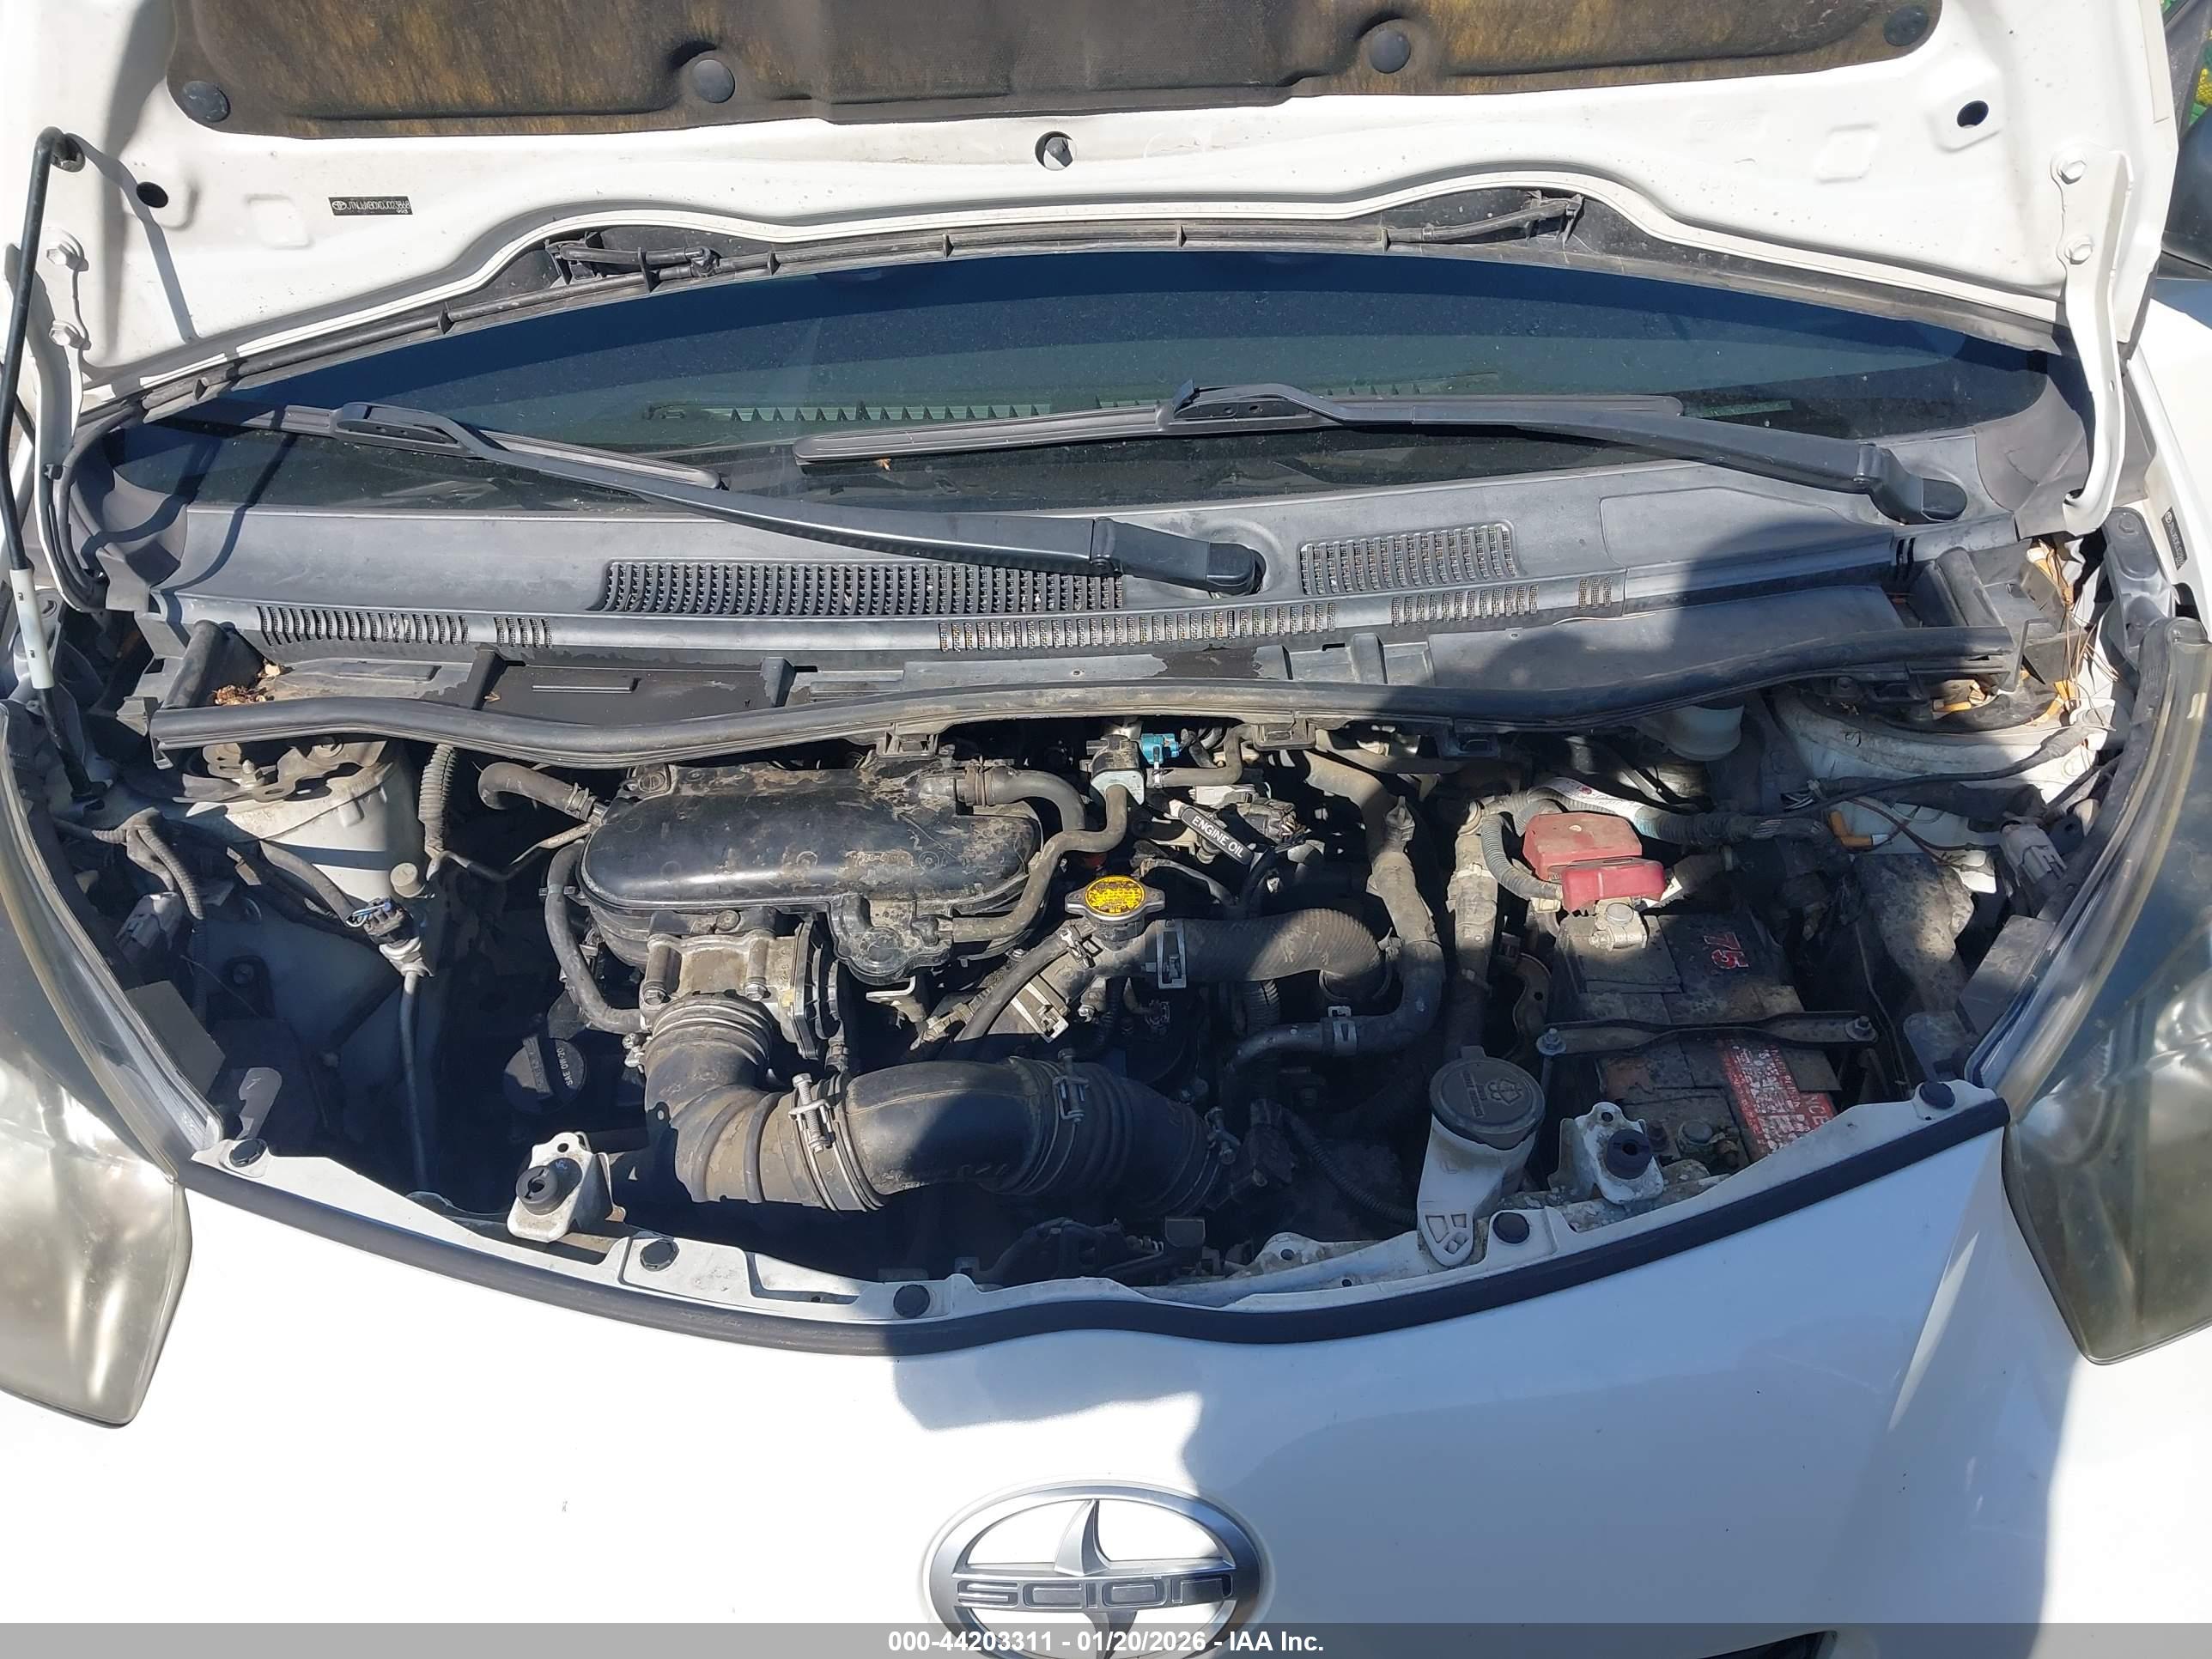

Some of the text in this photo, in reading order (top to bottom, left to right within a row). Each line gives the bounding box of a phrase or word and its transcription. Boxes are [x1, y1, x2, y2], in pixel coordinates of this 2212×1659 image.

[1191, 815, 1244, 859] ENGINE OIL
[1704, 931, 1749, 969] 75
[562, 1071, 574, 1086] SAE
